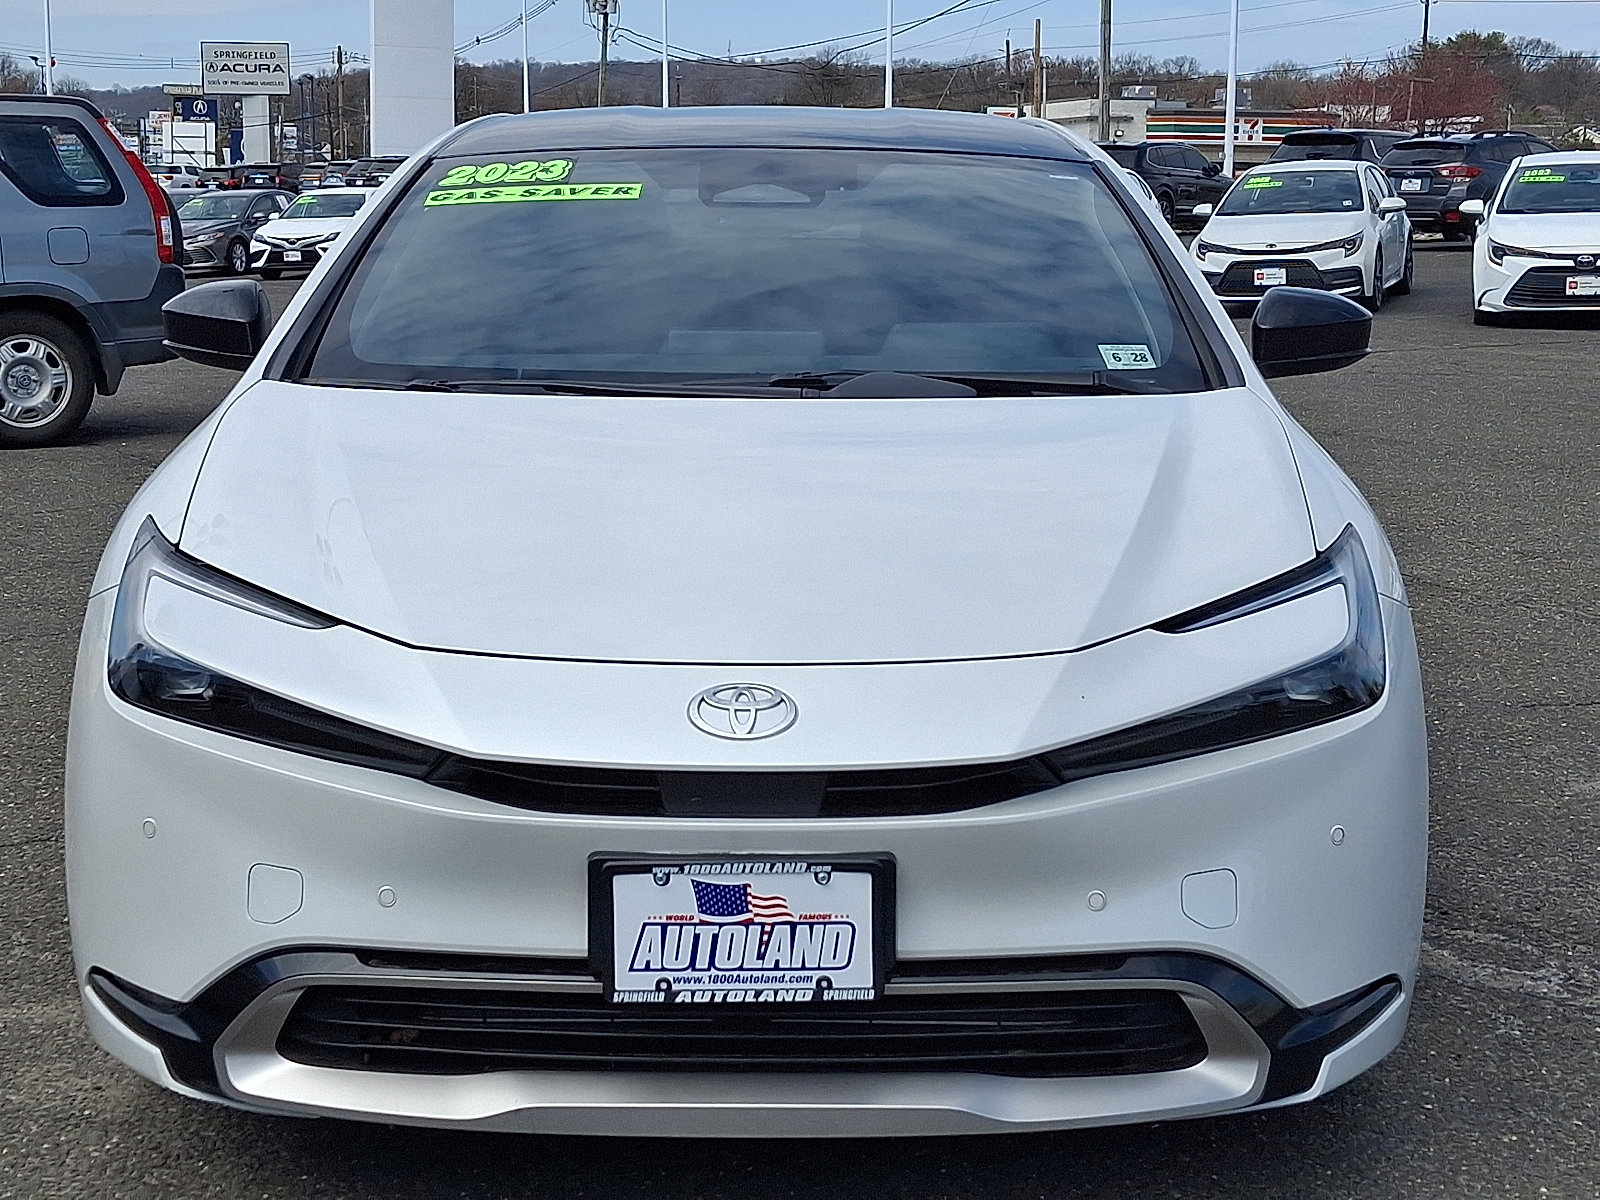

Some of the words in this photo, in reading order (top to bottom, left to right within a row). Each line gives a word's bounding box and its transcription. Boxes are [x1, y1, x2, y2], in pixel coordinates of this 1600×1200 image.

[213, 50, 276, 60] SPRINGFIELD
[219, 62, 286, 74] ACURA
[438, 159, 574, 187] 2023
[429, 186, 637, 202] GAS-SAVER
[1111, 352, 1123, 363] 6
[1130, 352, 1149, 363] 28
[652, 862, 832, 875] www.1800AUTOLAND.com
[665, 914, 695, 922] WORLD
[798, 913, 833, 921] FAMOUS
[629, 922, 856, 972] AUTOLAND
[672, 973, 814, 985] www.1800Autoland.com
[613, 990, 666, 1003] SPRINGFIELD
[674, 989, 814, 1003] AUTOLAND
[823, 988, 875, 1001] SPRINGFIELD
